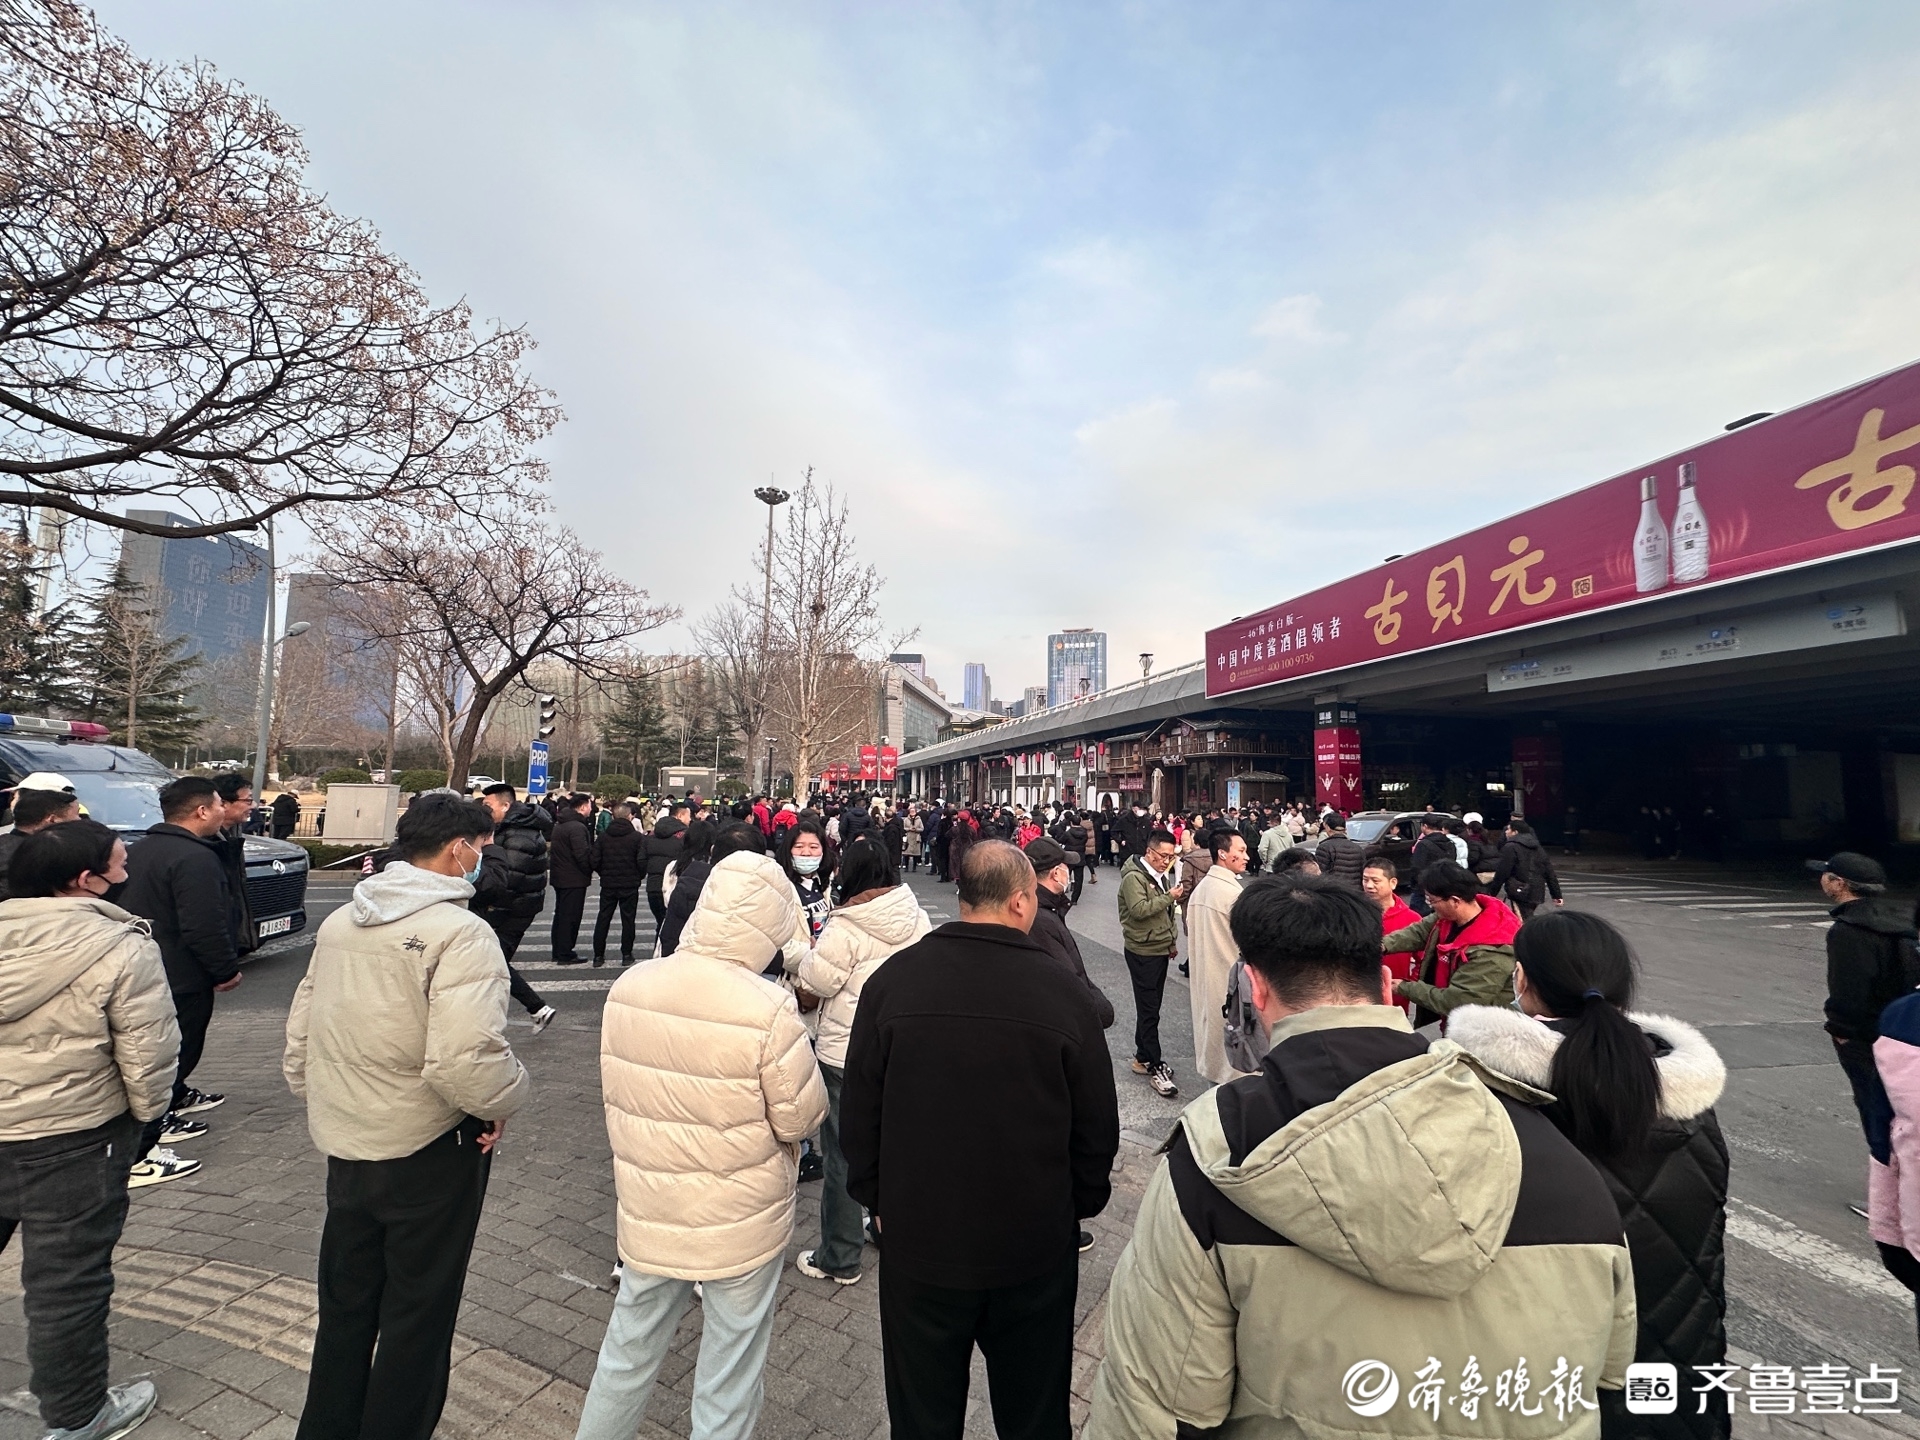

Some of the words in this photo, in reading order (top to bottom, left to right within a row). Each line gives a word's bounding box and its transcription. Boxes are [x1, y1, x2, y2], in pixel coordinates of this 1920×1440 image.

[1794, 407, 1920, 530] 古
[1217, 616, 1342, 672] 中国中度酱酒倡领者
[1267, 661, 1280, 673] 400
[1281, 658, 1294, 670] 100
[1295, 652, 1315, 667] 9736
